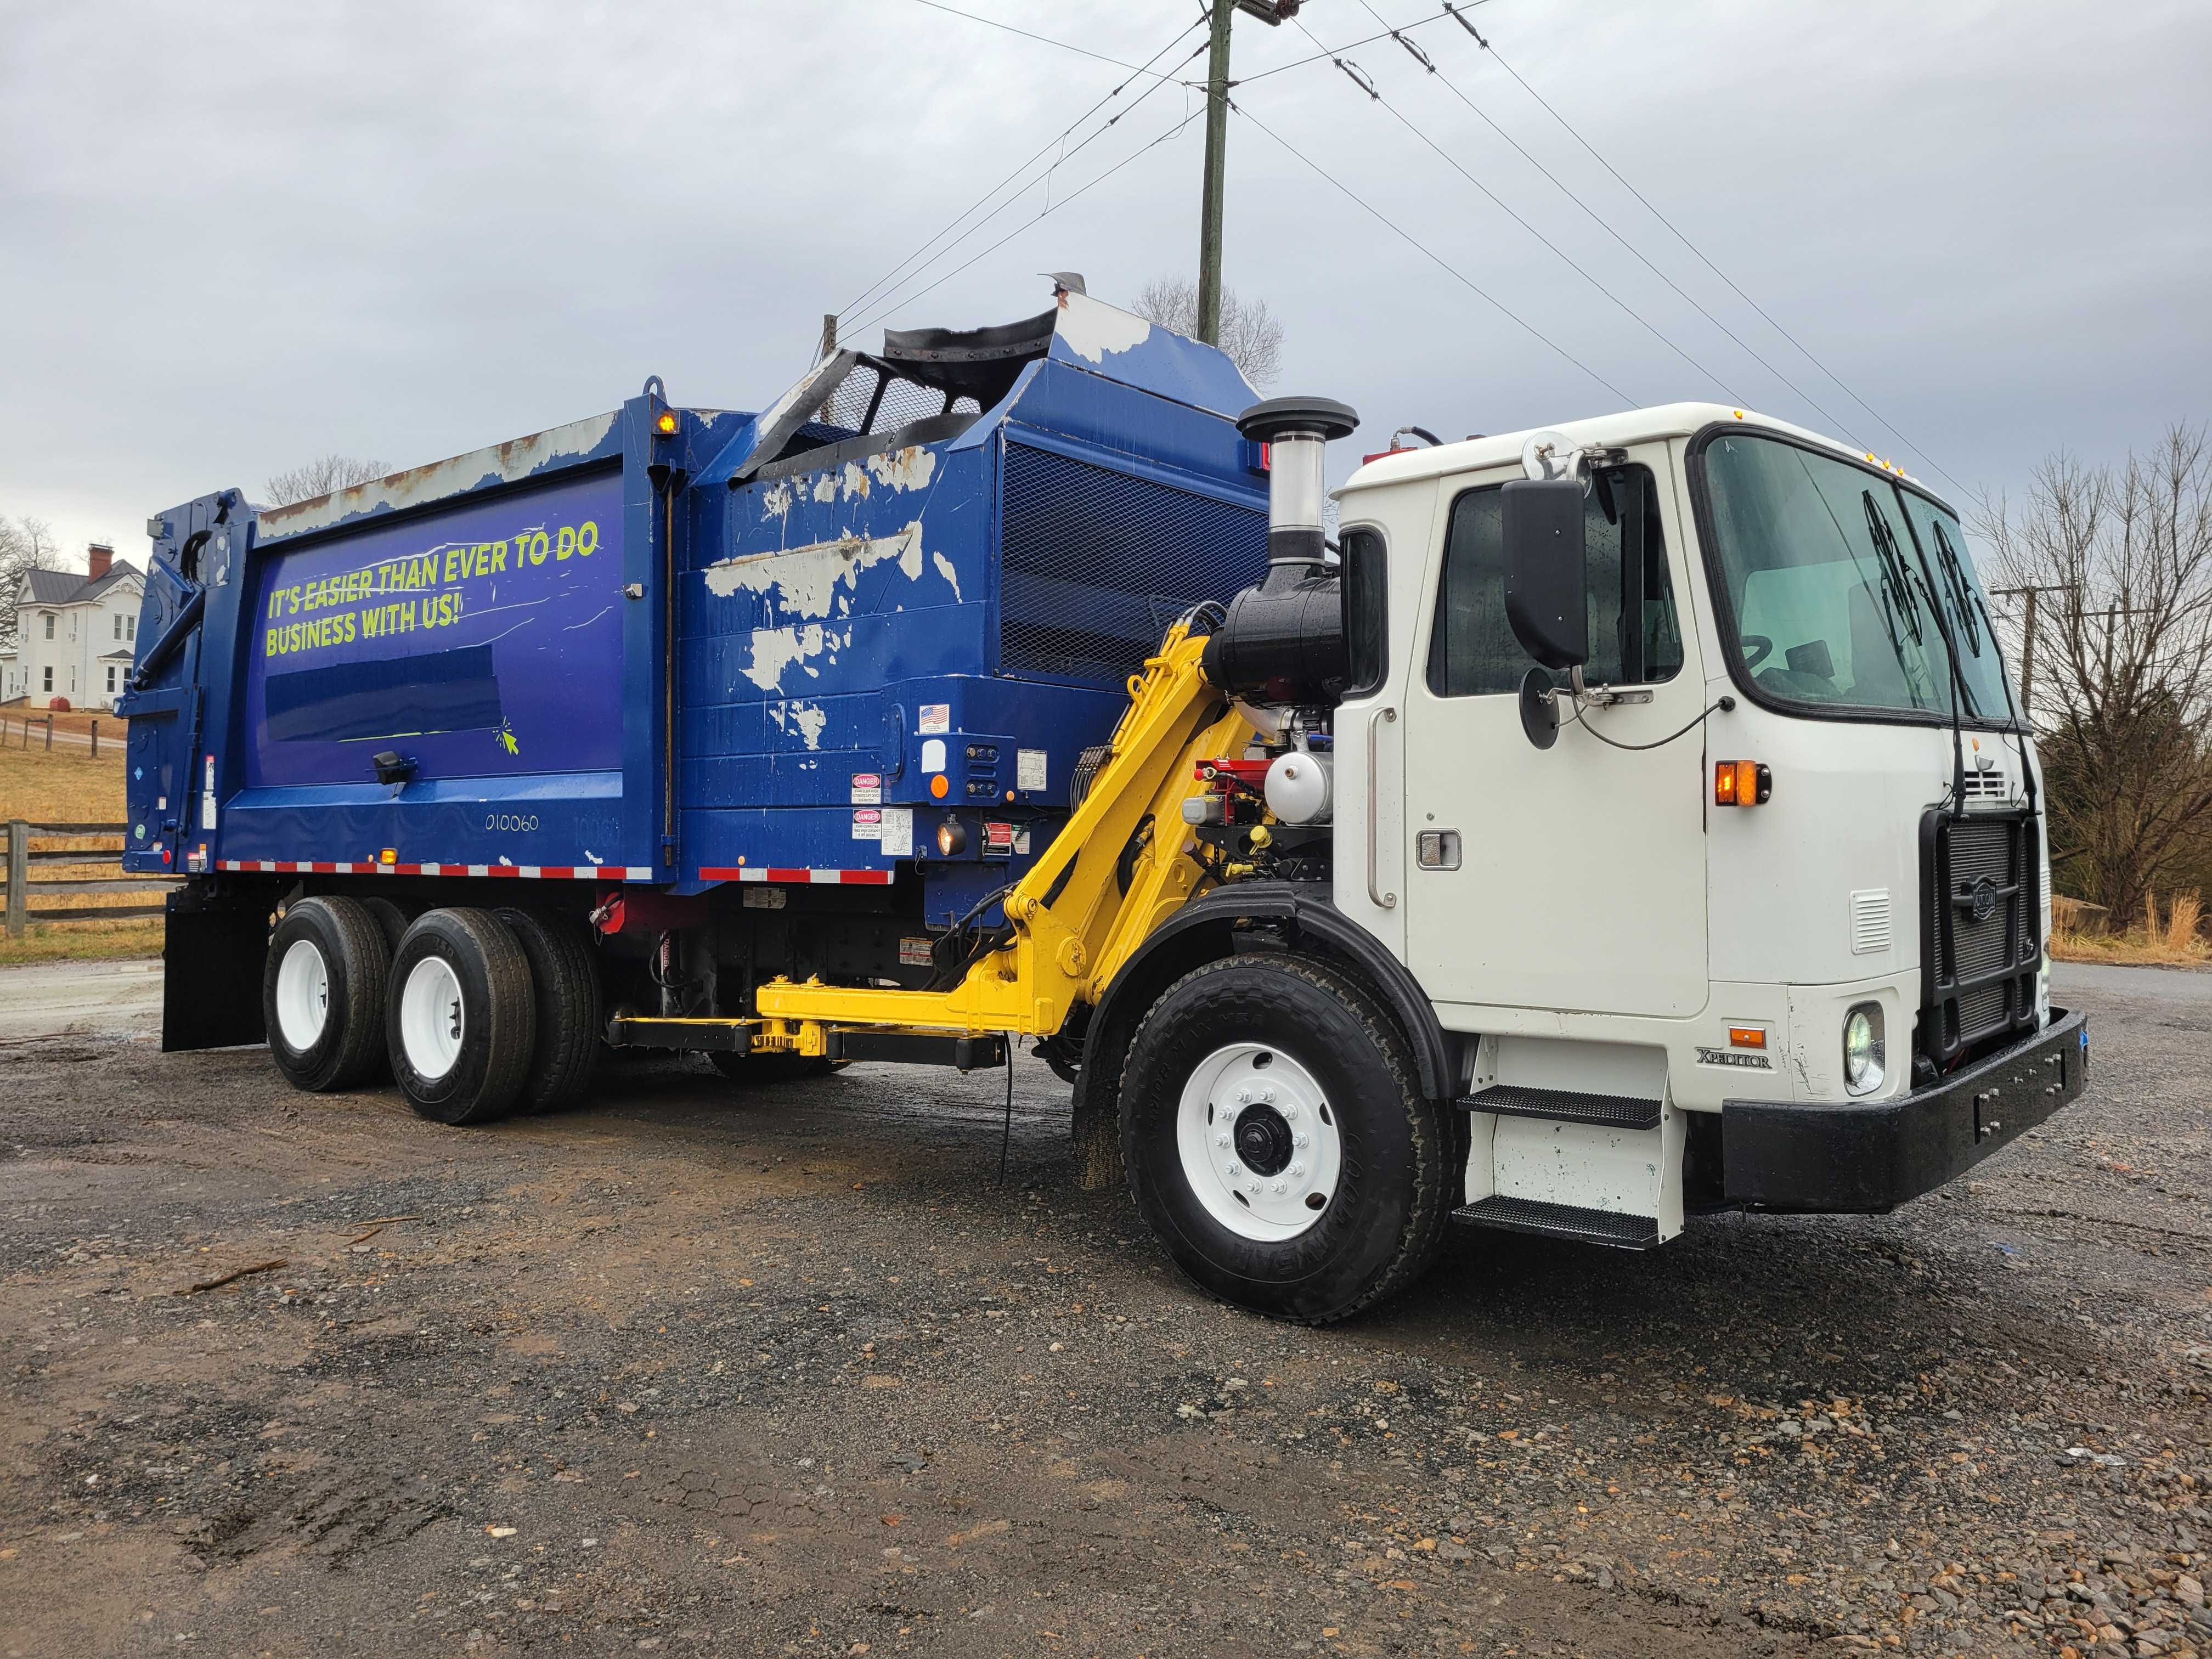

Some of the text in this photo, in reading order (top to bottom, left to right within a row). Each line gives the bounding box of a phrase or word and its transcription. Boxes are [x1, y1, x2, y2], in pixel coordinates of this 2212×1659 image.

[268, 521, 599, 619] IT'S EASIER THAN EVER TO DO
[266, 592, 460, 657] BUSINESS WITH US!
[485, 814, 539, 832] 010060
